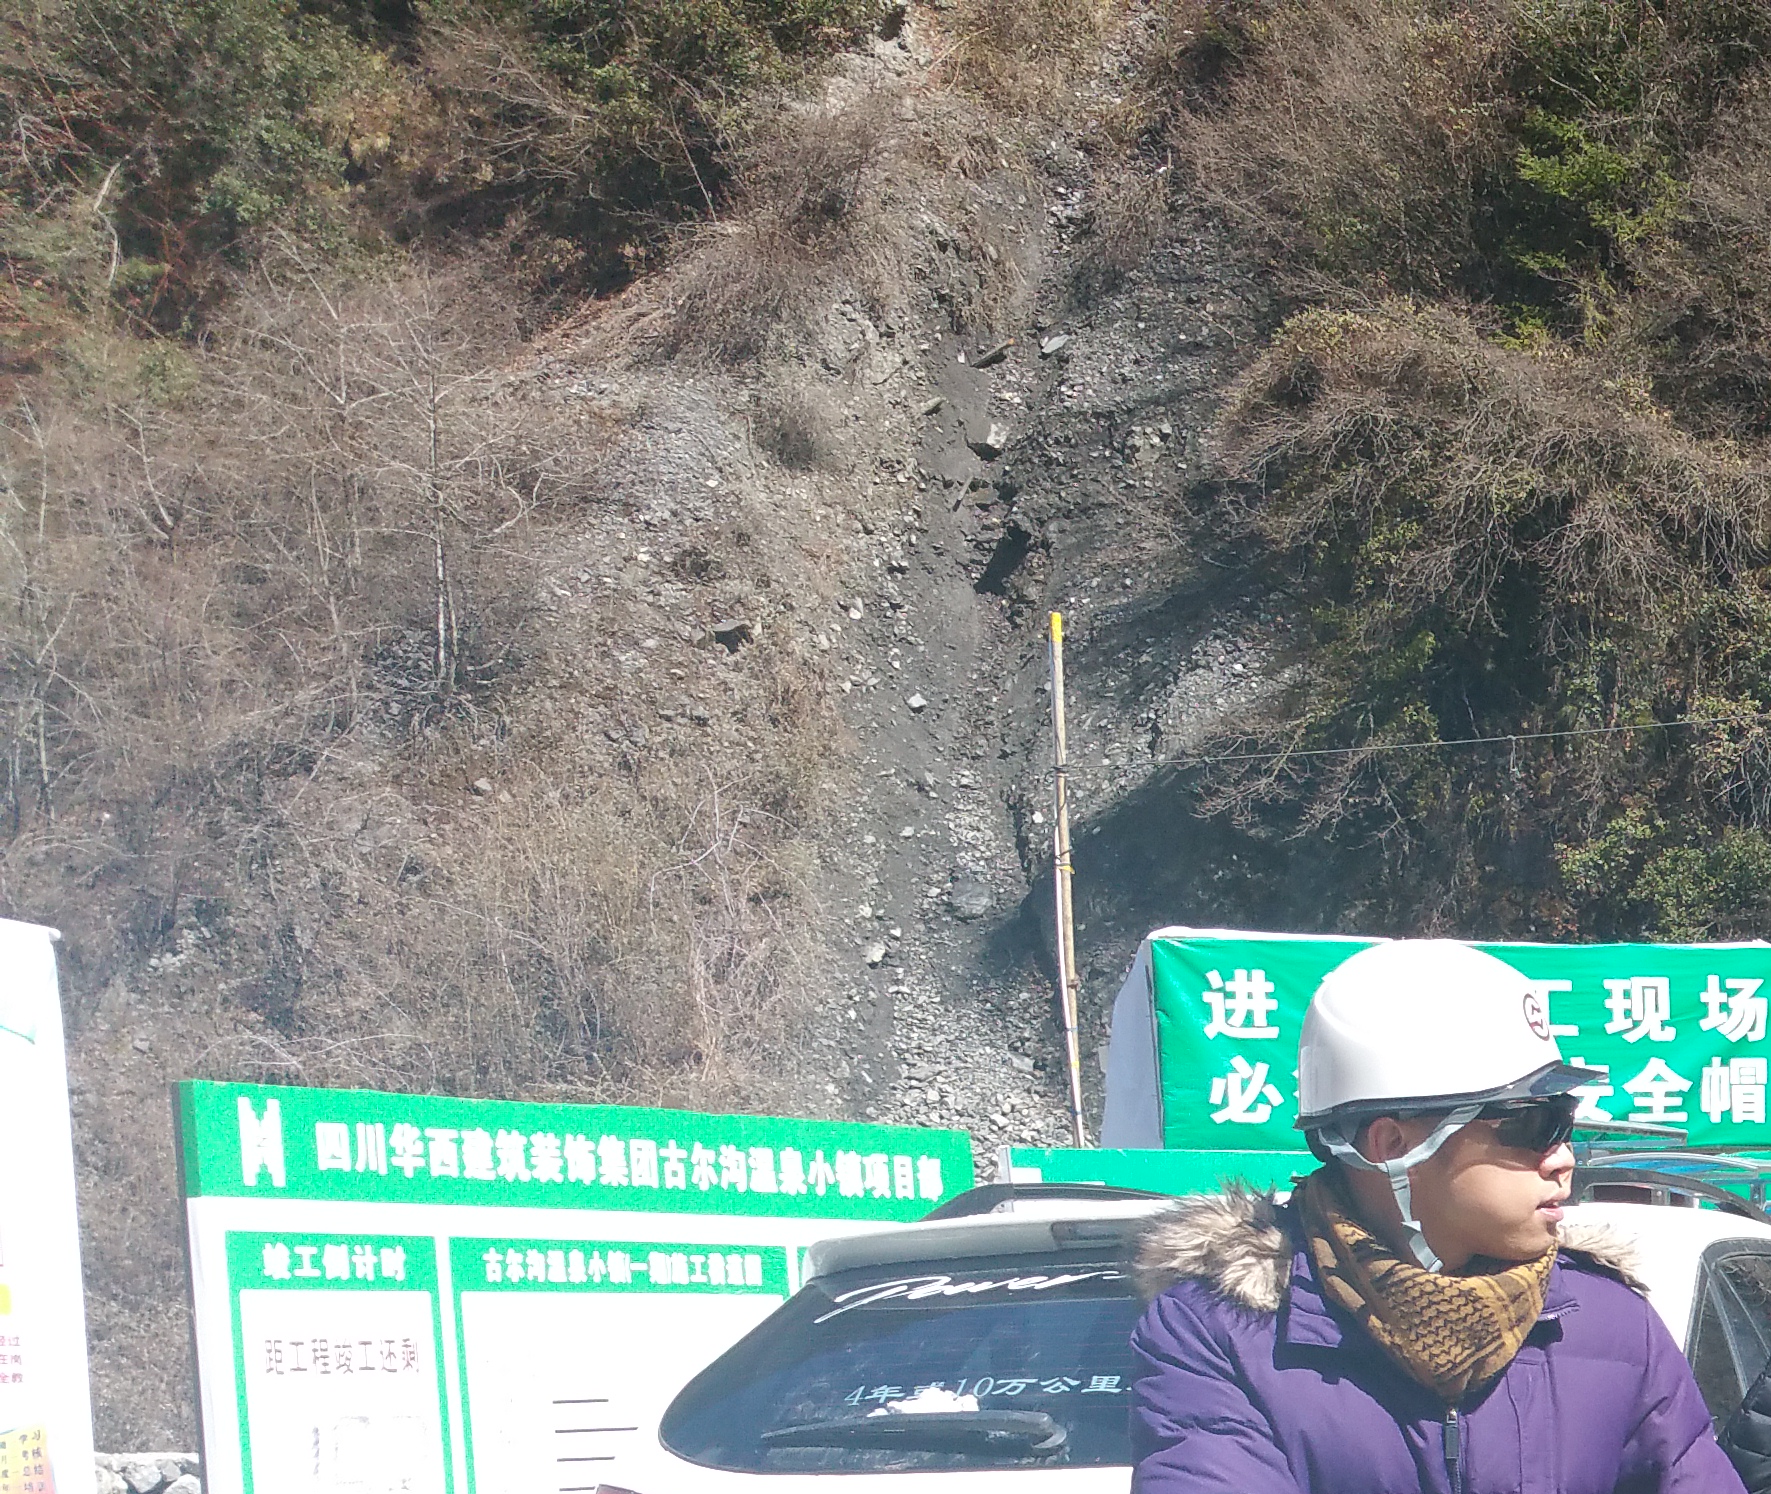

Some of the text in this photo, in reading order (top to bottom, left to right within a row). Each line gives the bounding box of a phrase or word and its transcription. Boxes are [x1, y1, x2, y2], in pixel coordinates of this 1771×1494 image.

[315, 1122, 943, 1202] 四川华西建筑装饰集团古尔沟温泉小镇项目部
[262, 1242, 406, 1282] 竣工倒计时
[264, 1338, 419, 1375] 距工程竣工还剩
